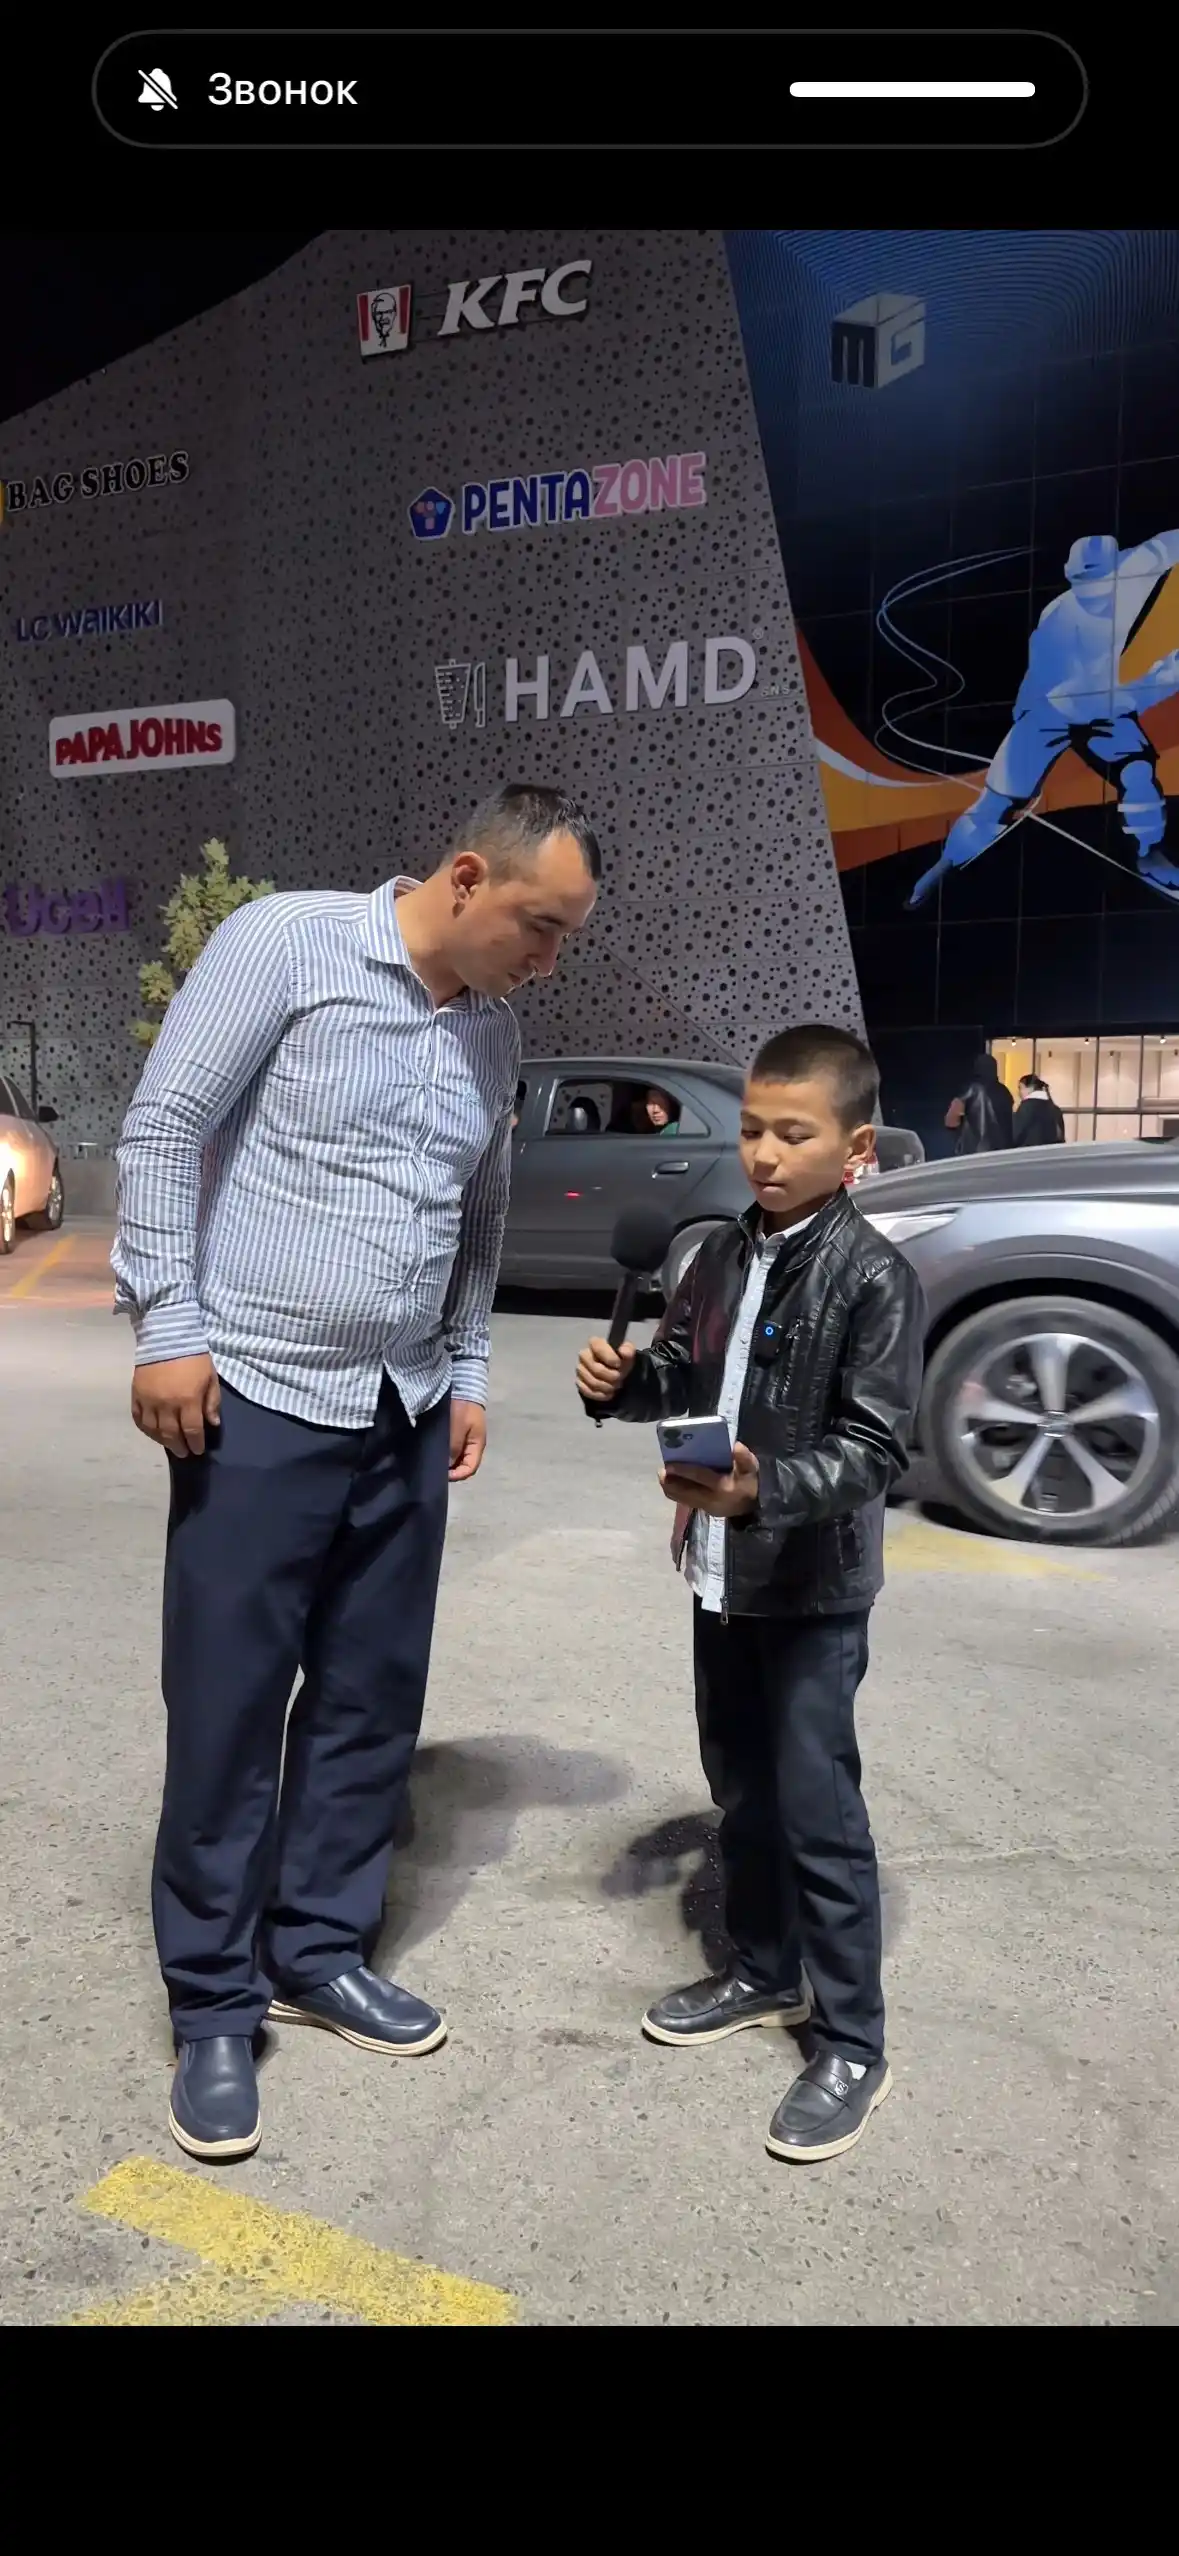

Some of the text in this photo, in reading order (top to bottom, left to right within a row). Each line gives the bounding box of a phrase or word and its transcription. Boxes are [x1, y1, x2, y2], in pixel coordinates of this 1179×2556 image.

[437, 260, 592, 336] KFC
[7, 451, 189, 511] BAG SHOES
[17, 616, 50, 642] LC
[504, 637, 756, 722] HAMD
